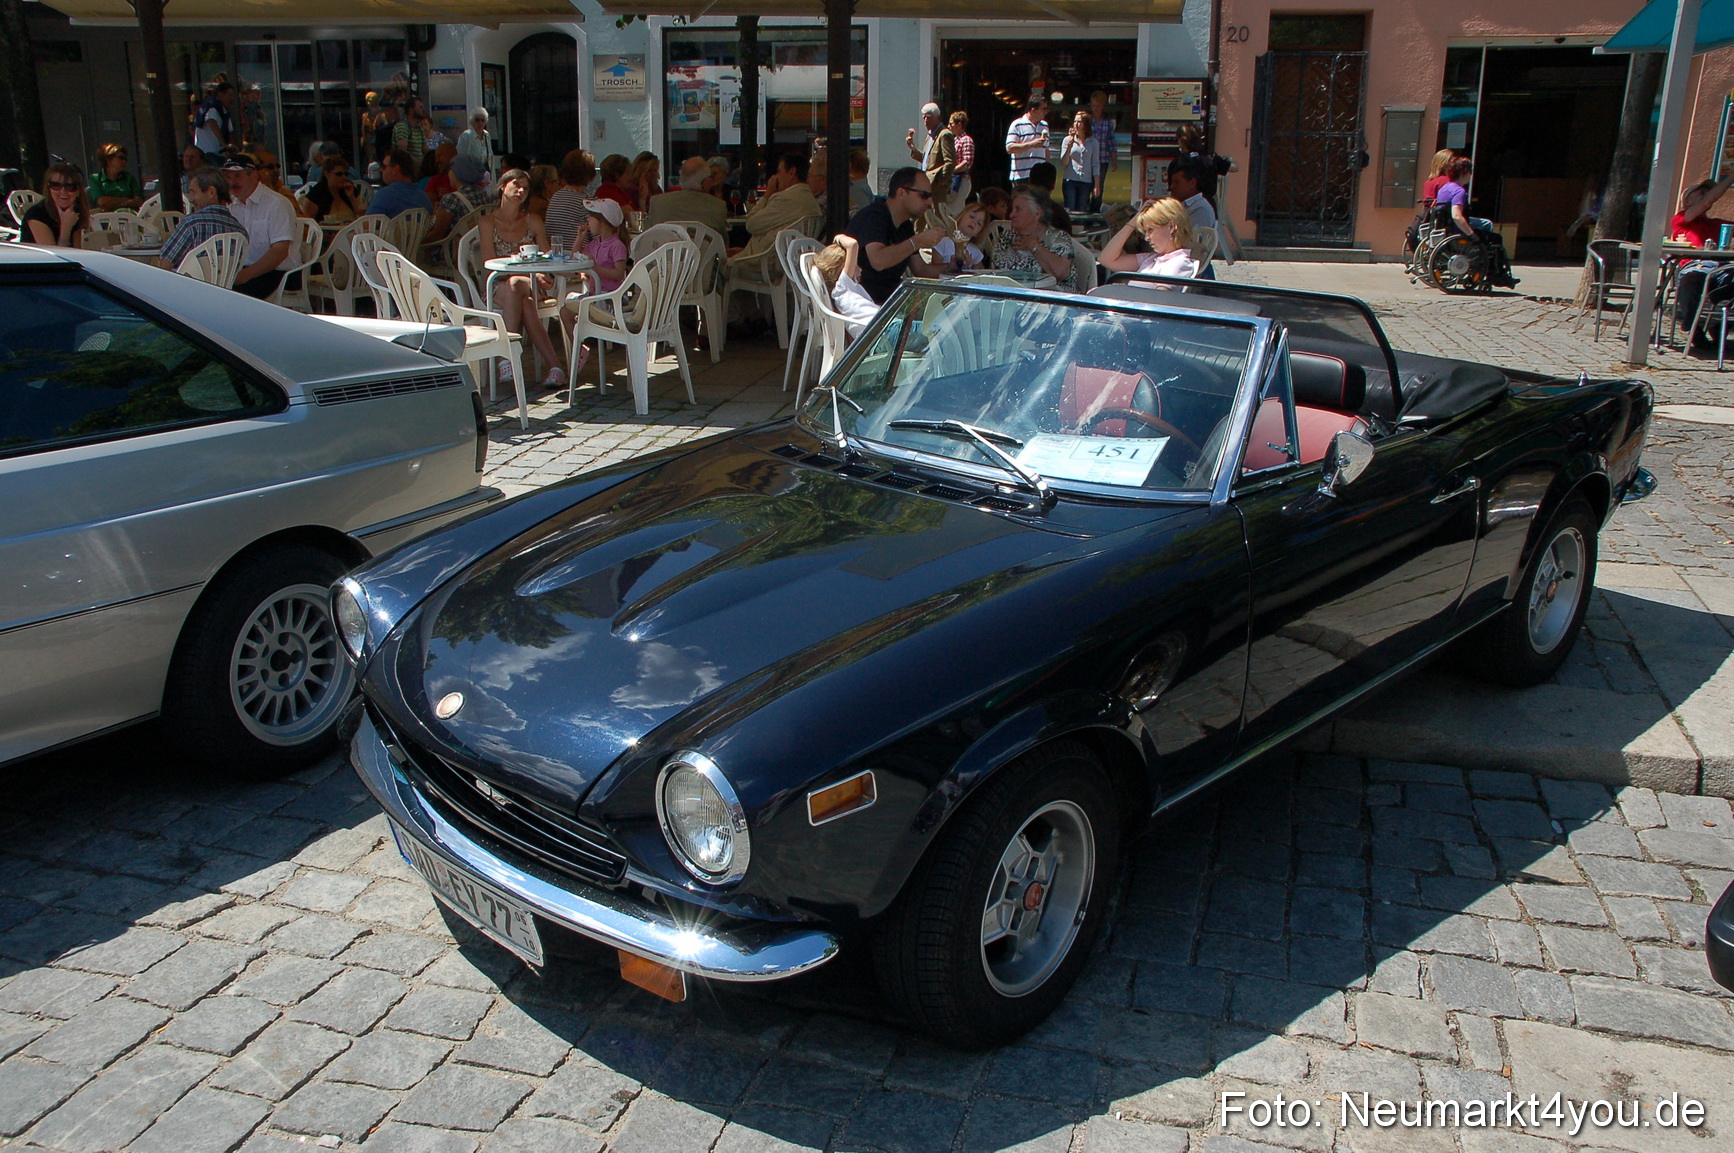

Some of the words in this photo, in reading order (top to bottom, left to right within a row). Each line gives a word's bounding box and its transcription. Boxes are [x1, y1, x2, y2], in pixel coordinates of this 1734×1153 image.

[1227, 26, 1249, 43] 20
[1088, 444, 1140, 460] 451
[447, 869, 480, 917] EY
[481, 891, 513, 938] 77
